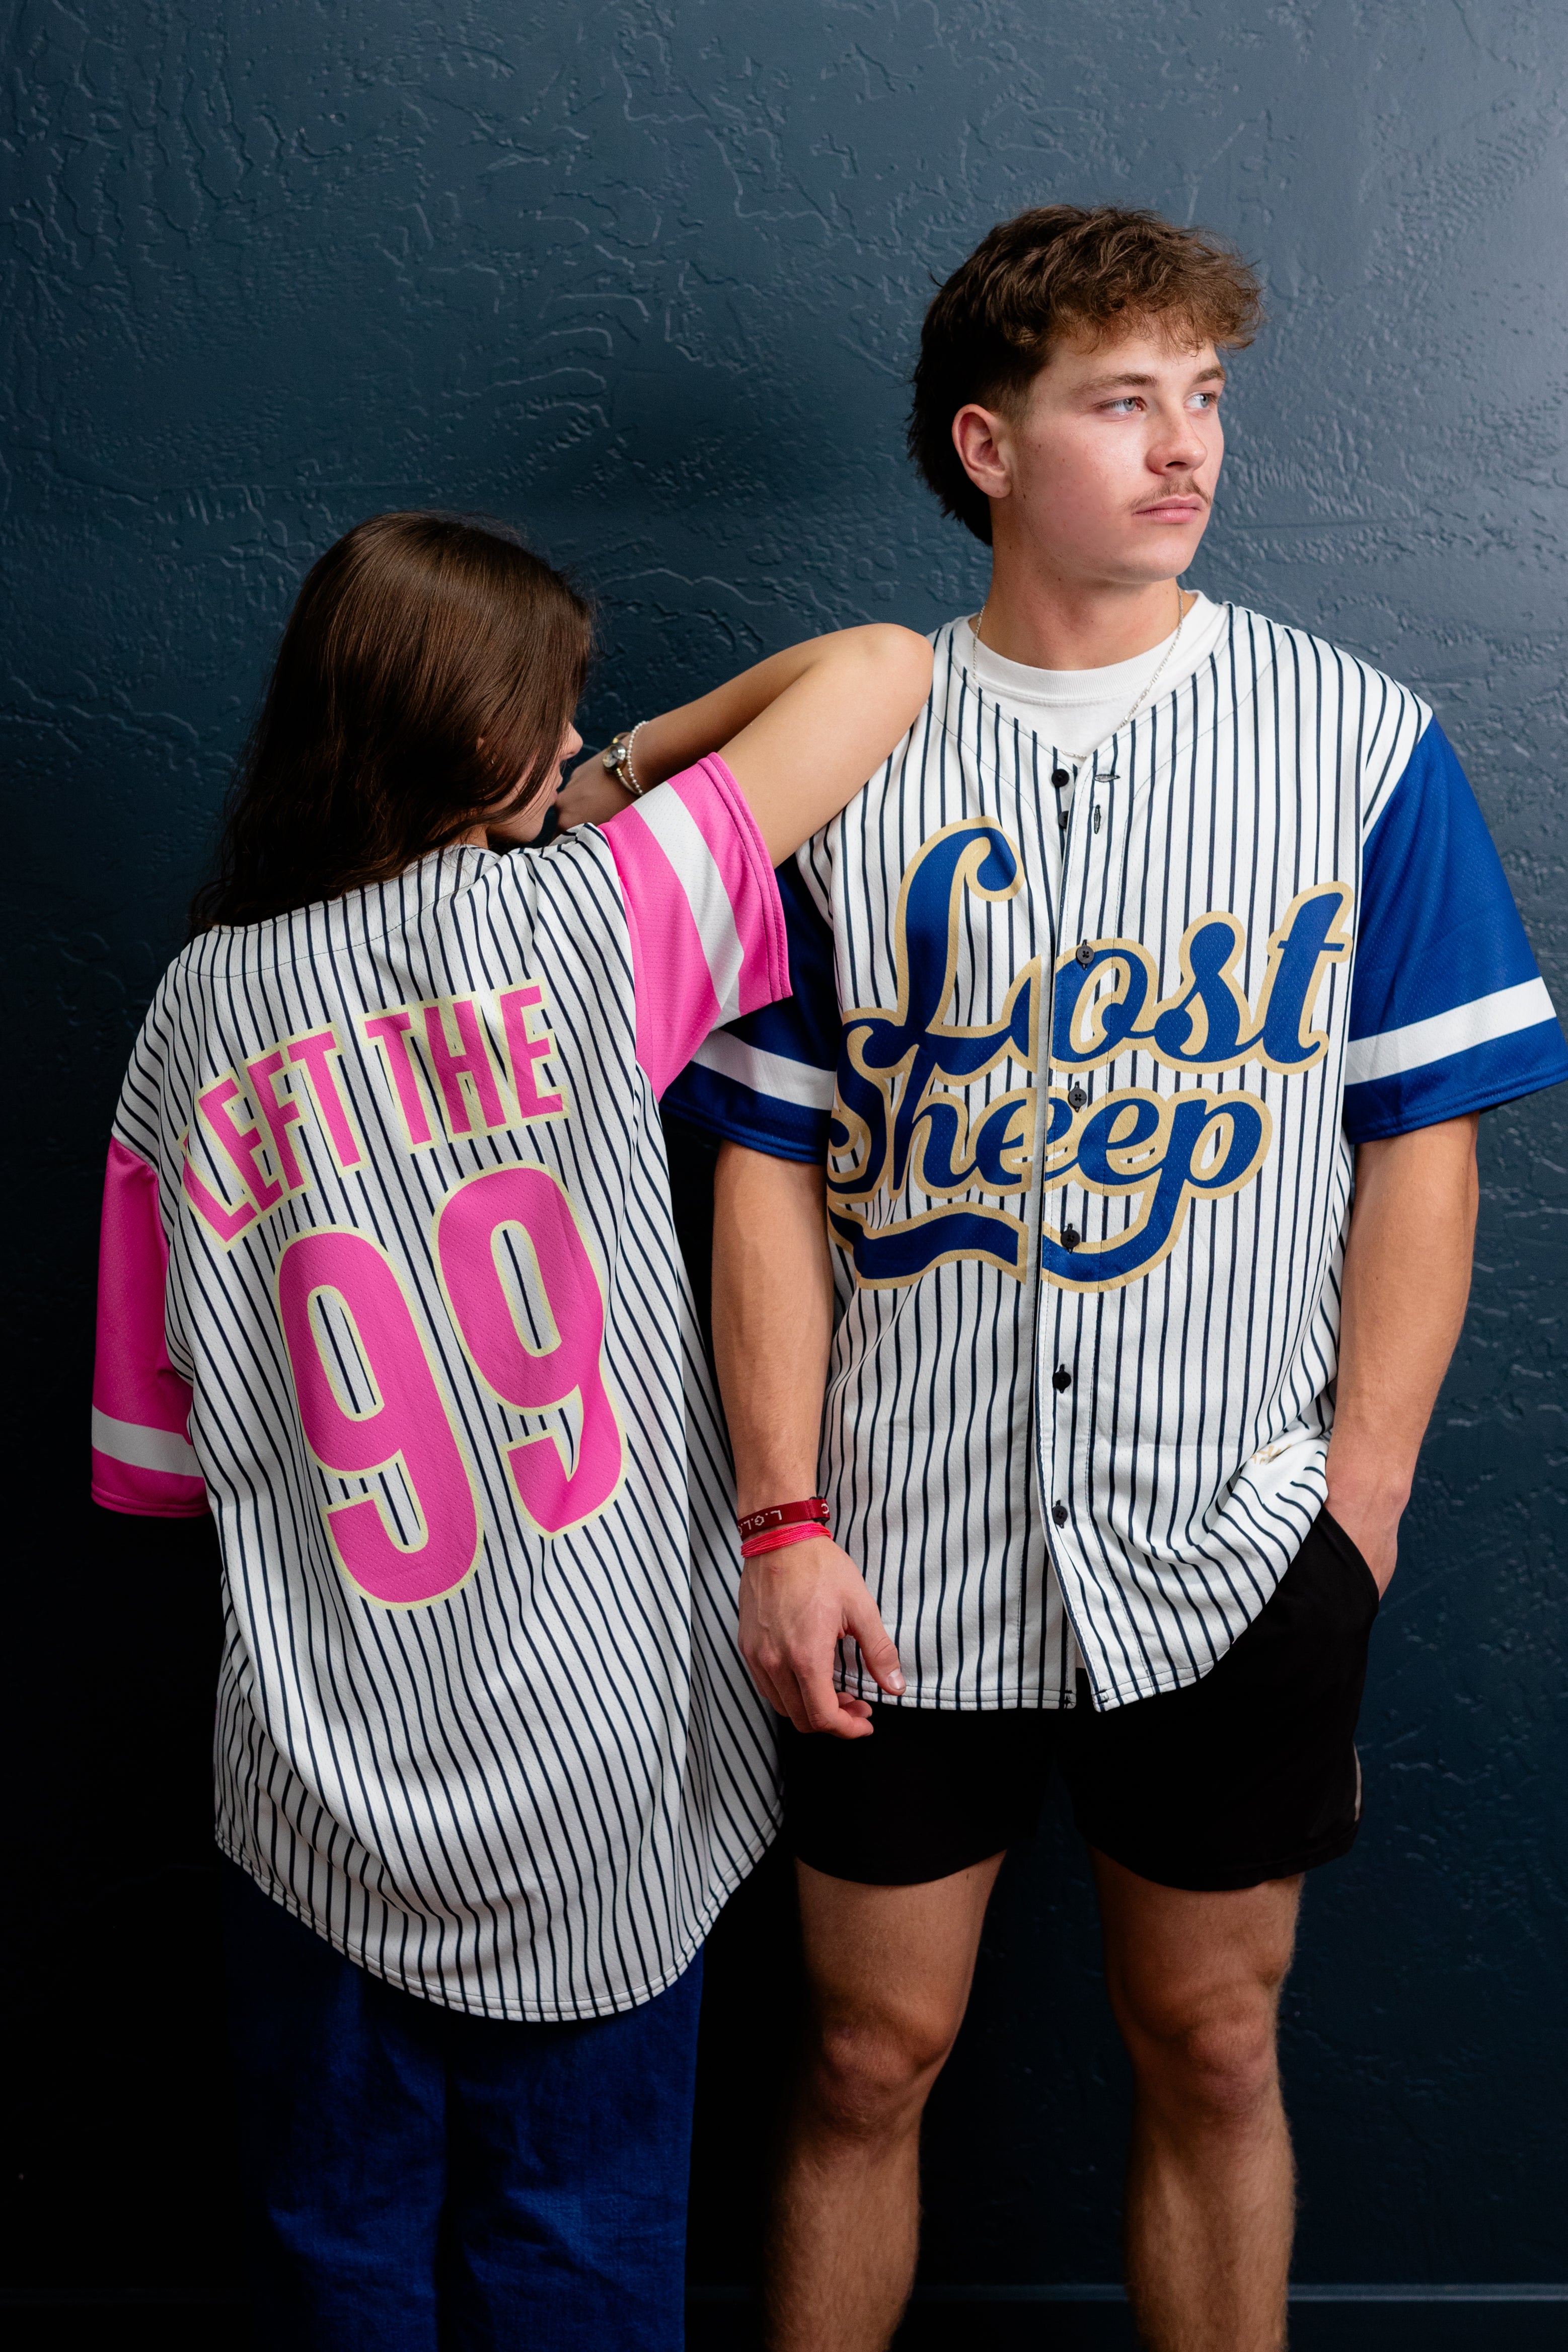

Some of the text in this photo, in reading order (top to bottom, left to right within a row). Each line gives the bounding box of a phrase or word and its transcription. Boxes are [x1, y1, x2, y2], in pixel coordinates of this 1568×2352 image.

[851, 815, 1355, 1087] Lost
[177, 977, 571, 1251] LEFT THE
[826, 1009, 1274, 1293] Sheep
[273, 1159, 628, 1612] 99
